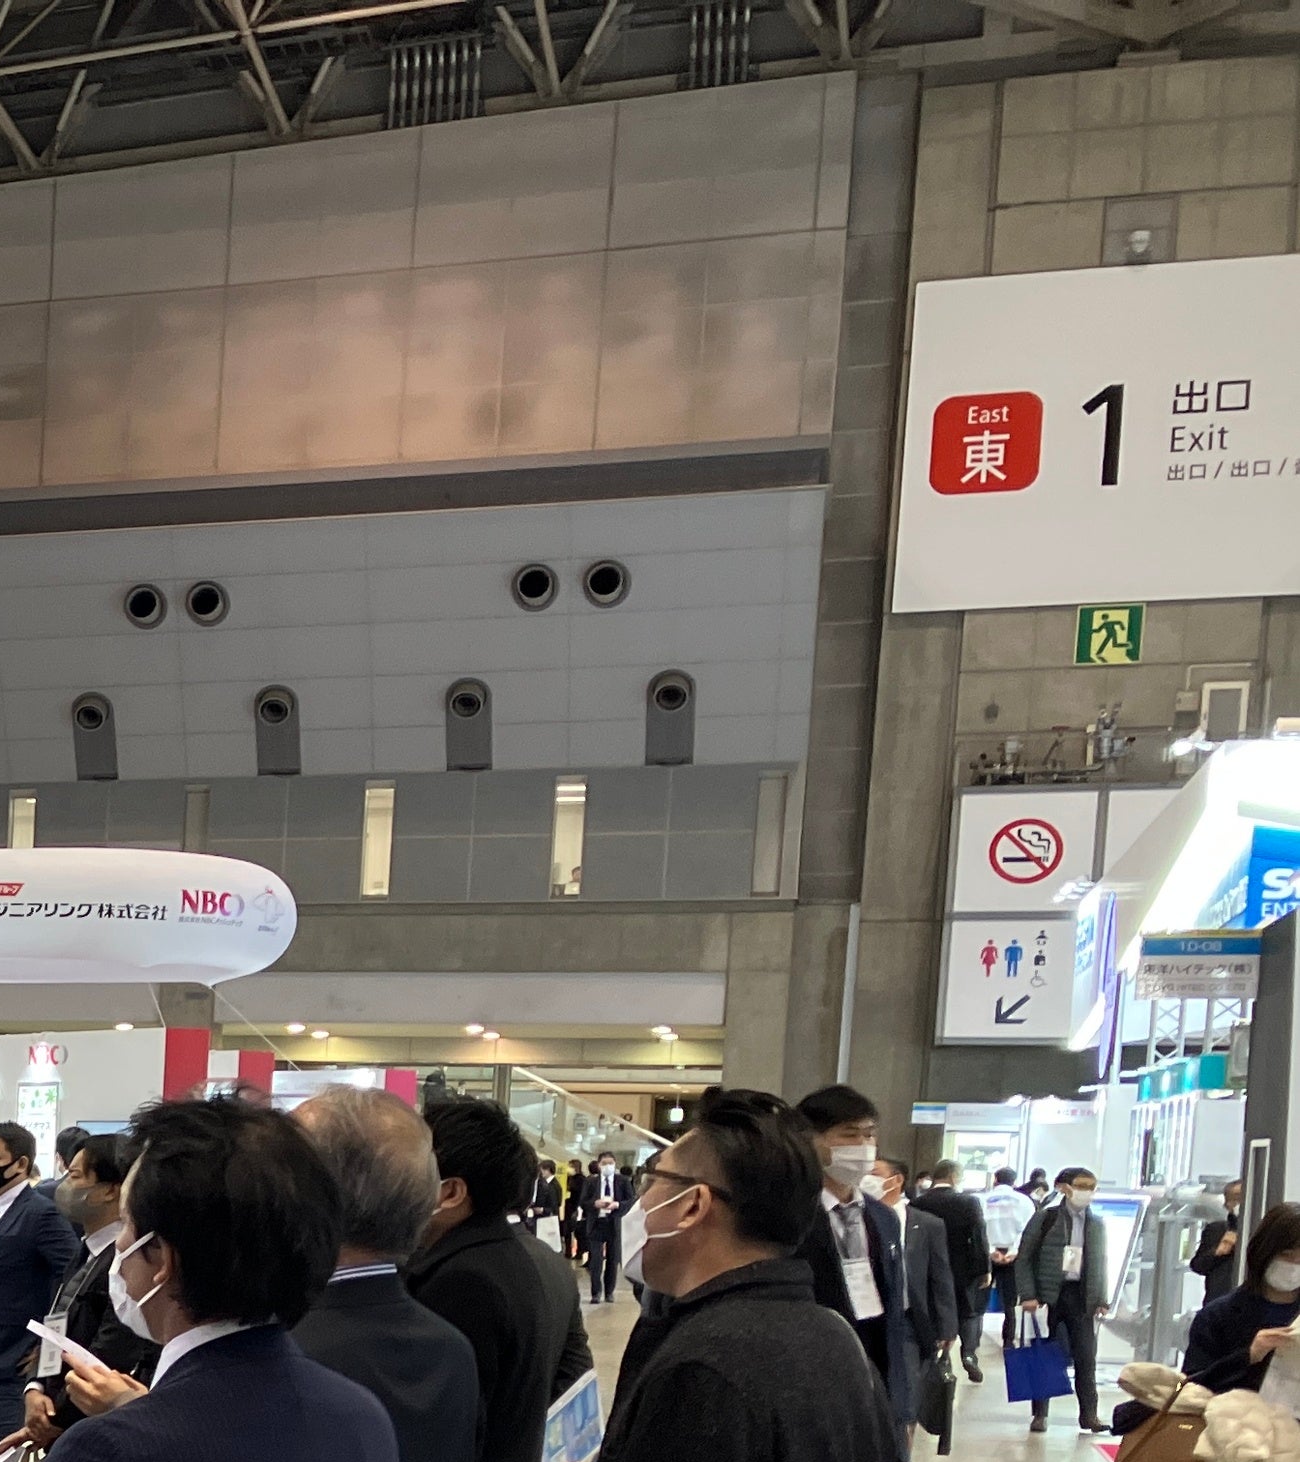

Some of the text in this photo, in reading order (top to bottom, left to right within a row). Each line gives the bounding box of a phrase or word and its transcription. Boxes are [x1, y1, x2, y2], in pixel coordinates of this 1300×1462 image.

[1173, 379, 1251, 414] 出口
[967, 405, 1010, 424] East
[1082, 384, 1124, 486] 1
[1170, 423, 1229, 452] Exit
[960, 429, 1010, 484] 東
